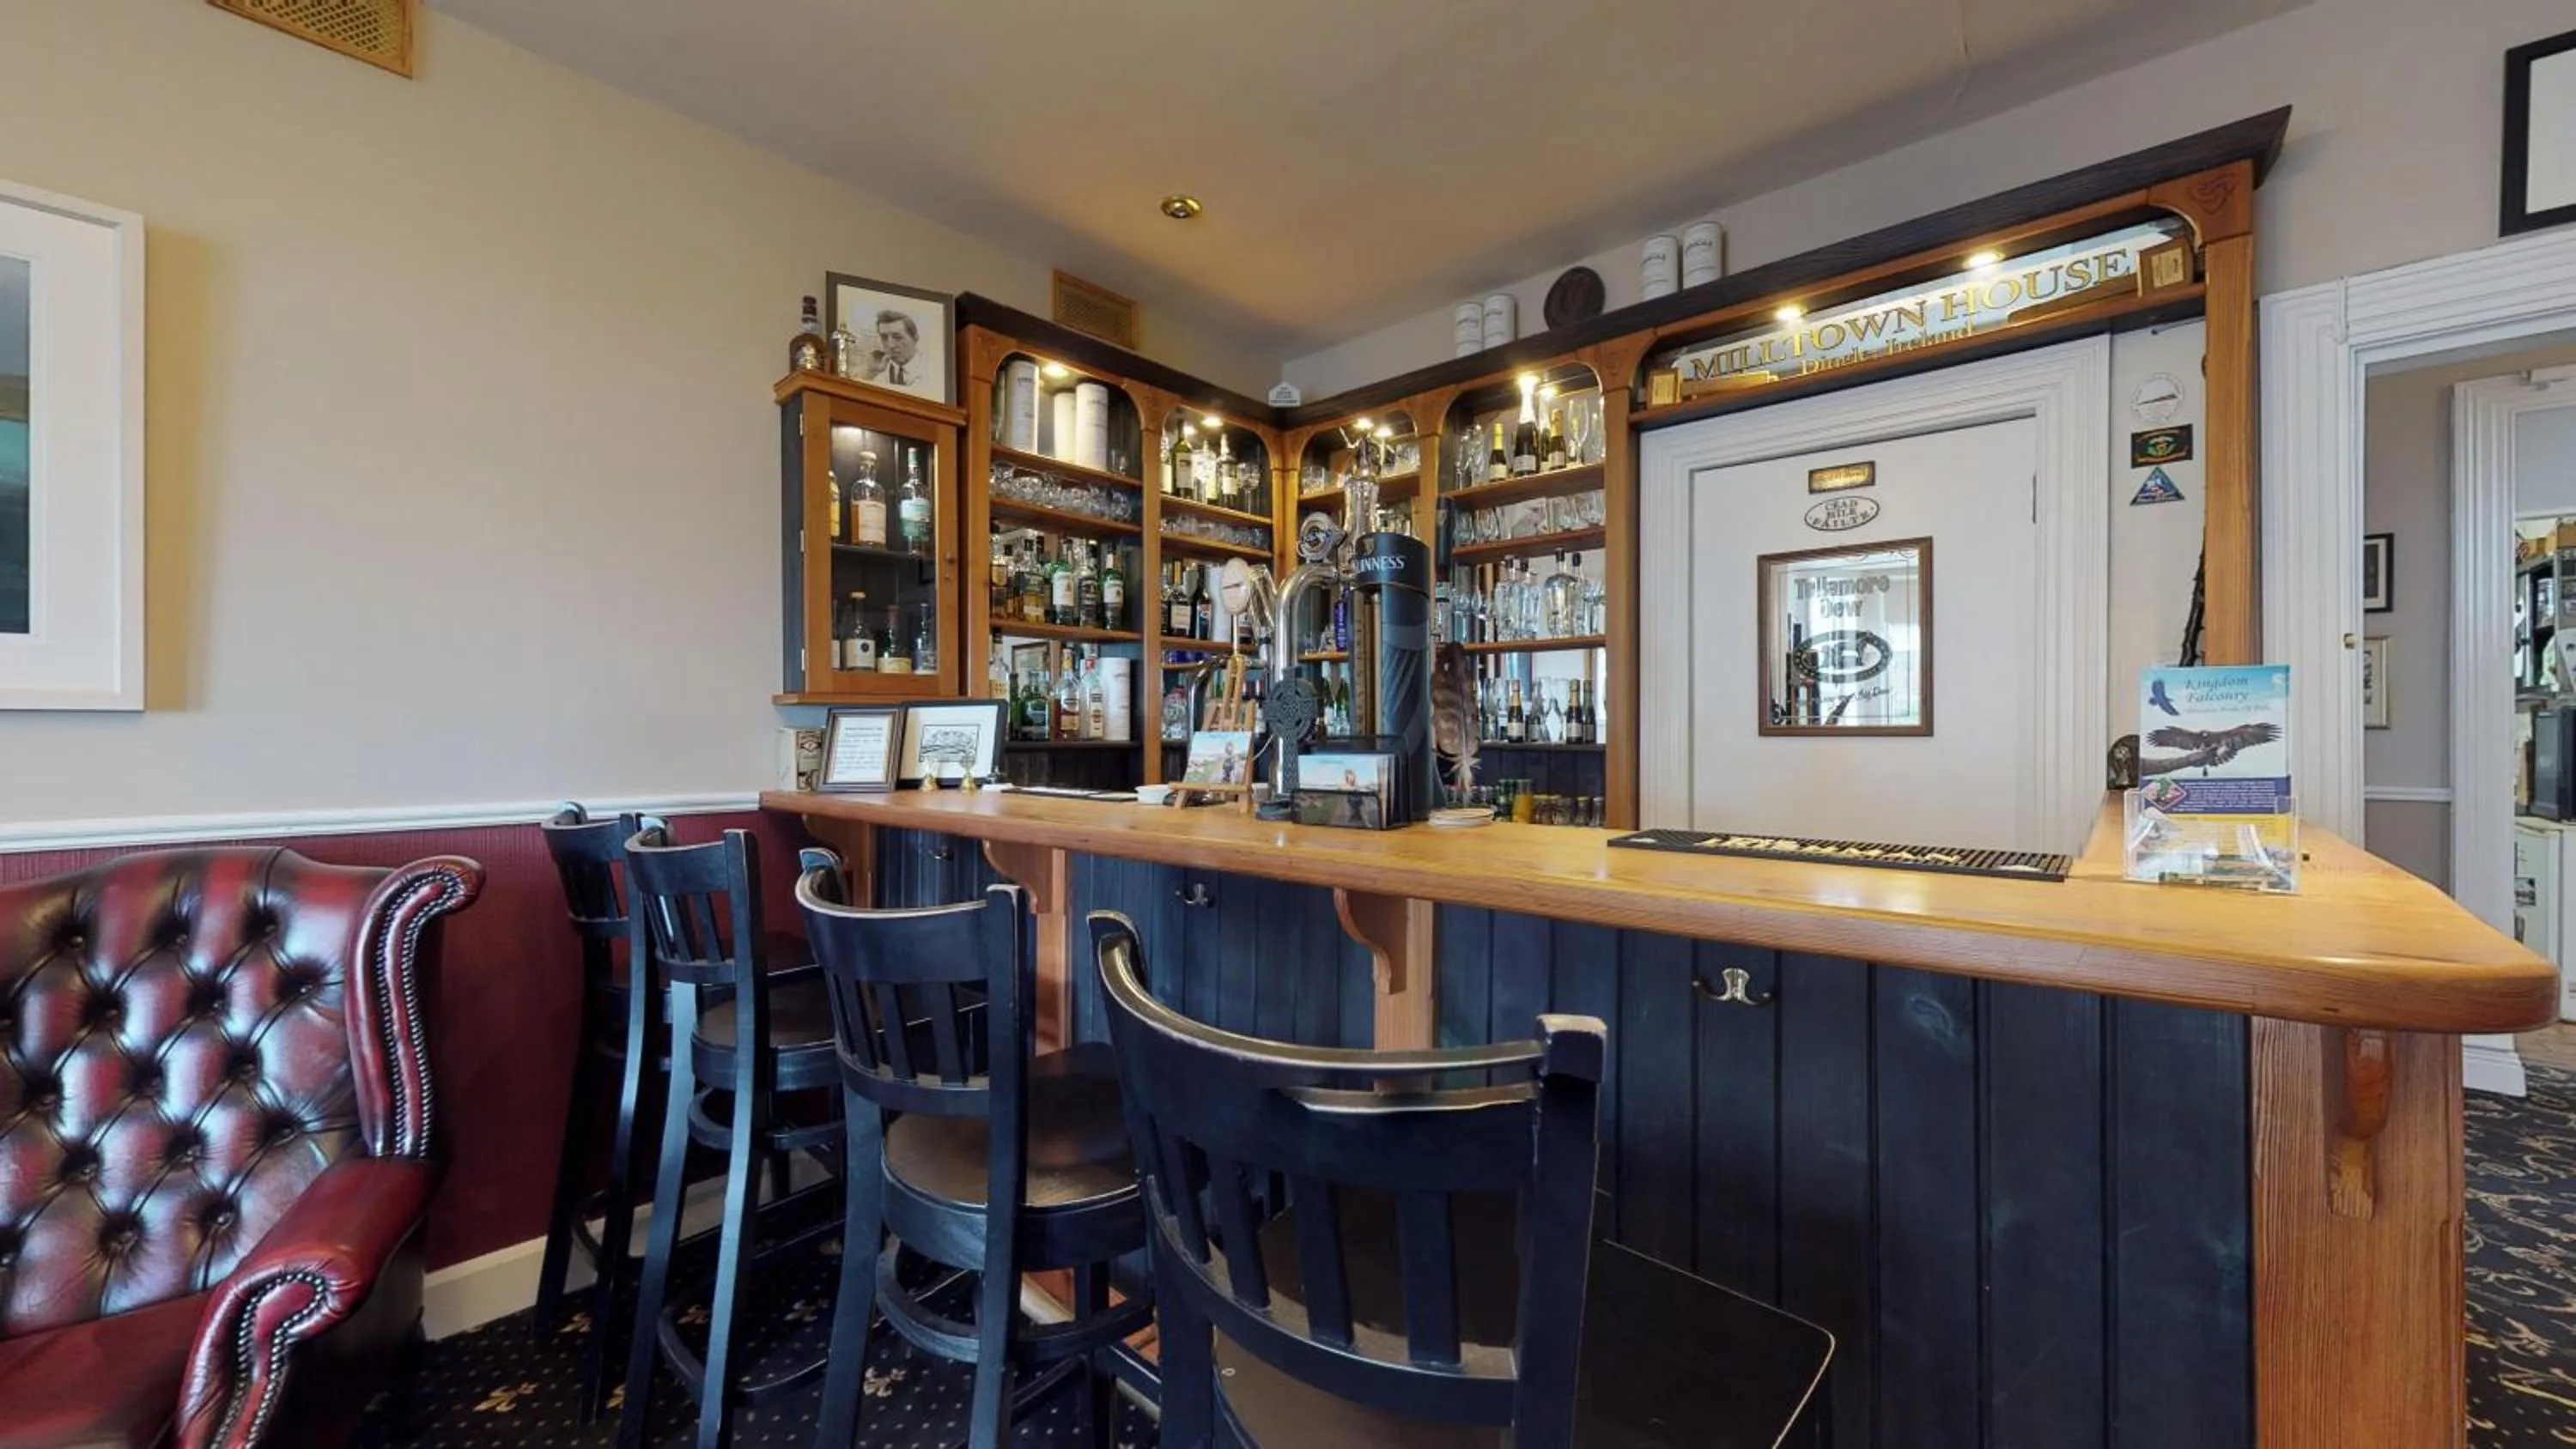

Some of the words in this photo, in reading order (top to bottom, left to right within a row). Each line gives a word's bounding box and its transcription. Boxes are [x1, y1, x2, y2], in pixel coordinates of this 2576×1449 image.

[1689, 299, 1928, 379] MILLTOWN
[1940, 249, 2131, 322] HOUSE
[2184, 675, 2249, 692] Kingdom
[2185, 691, 2250, 703] Falconry
